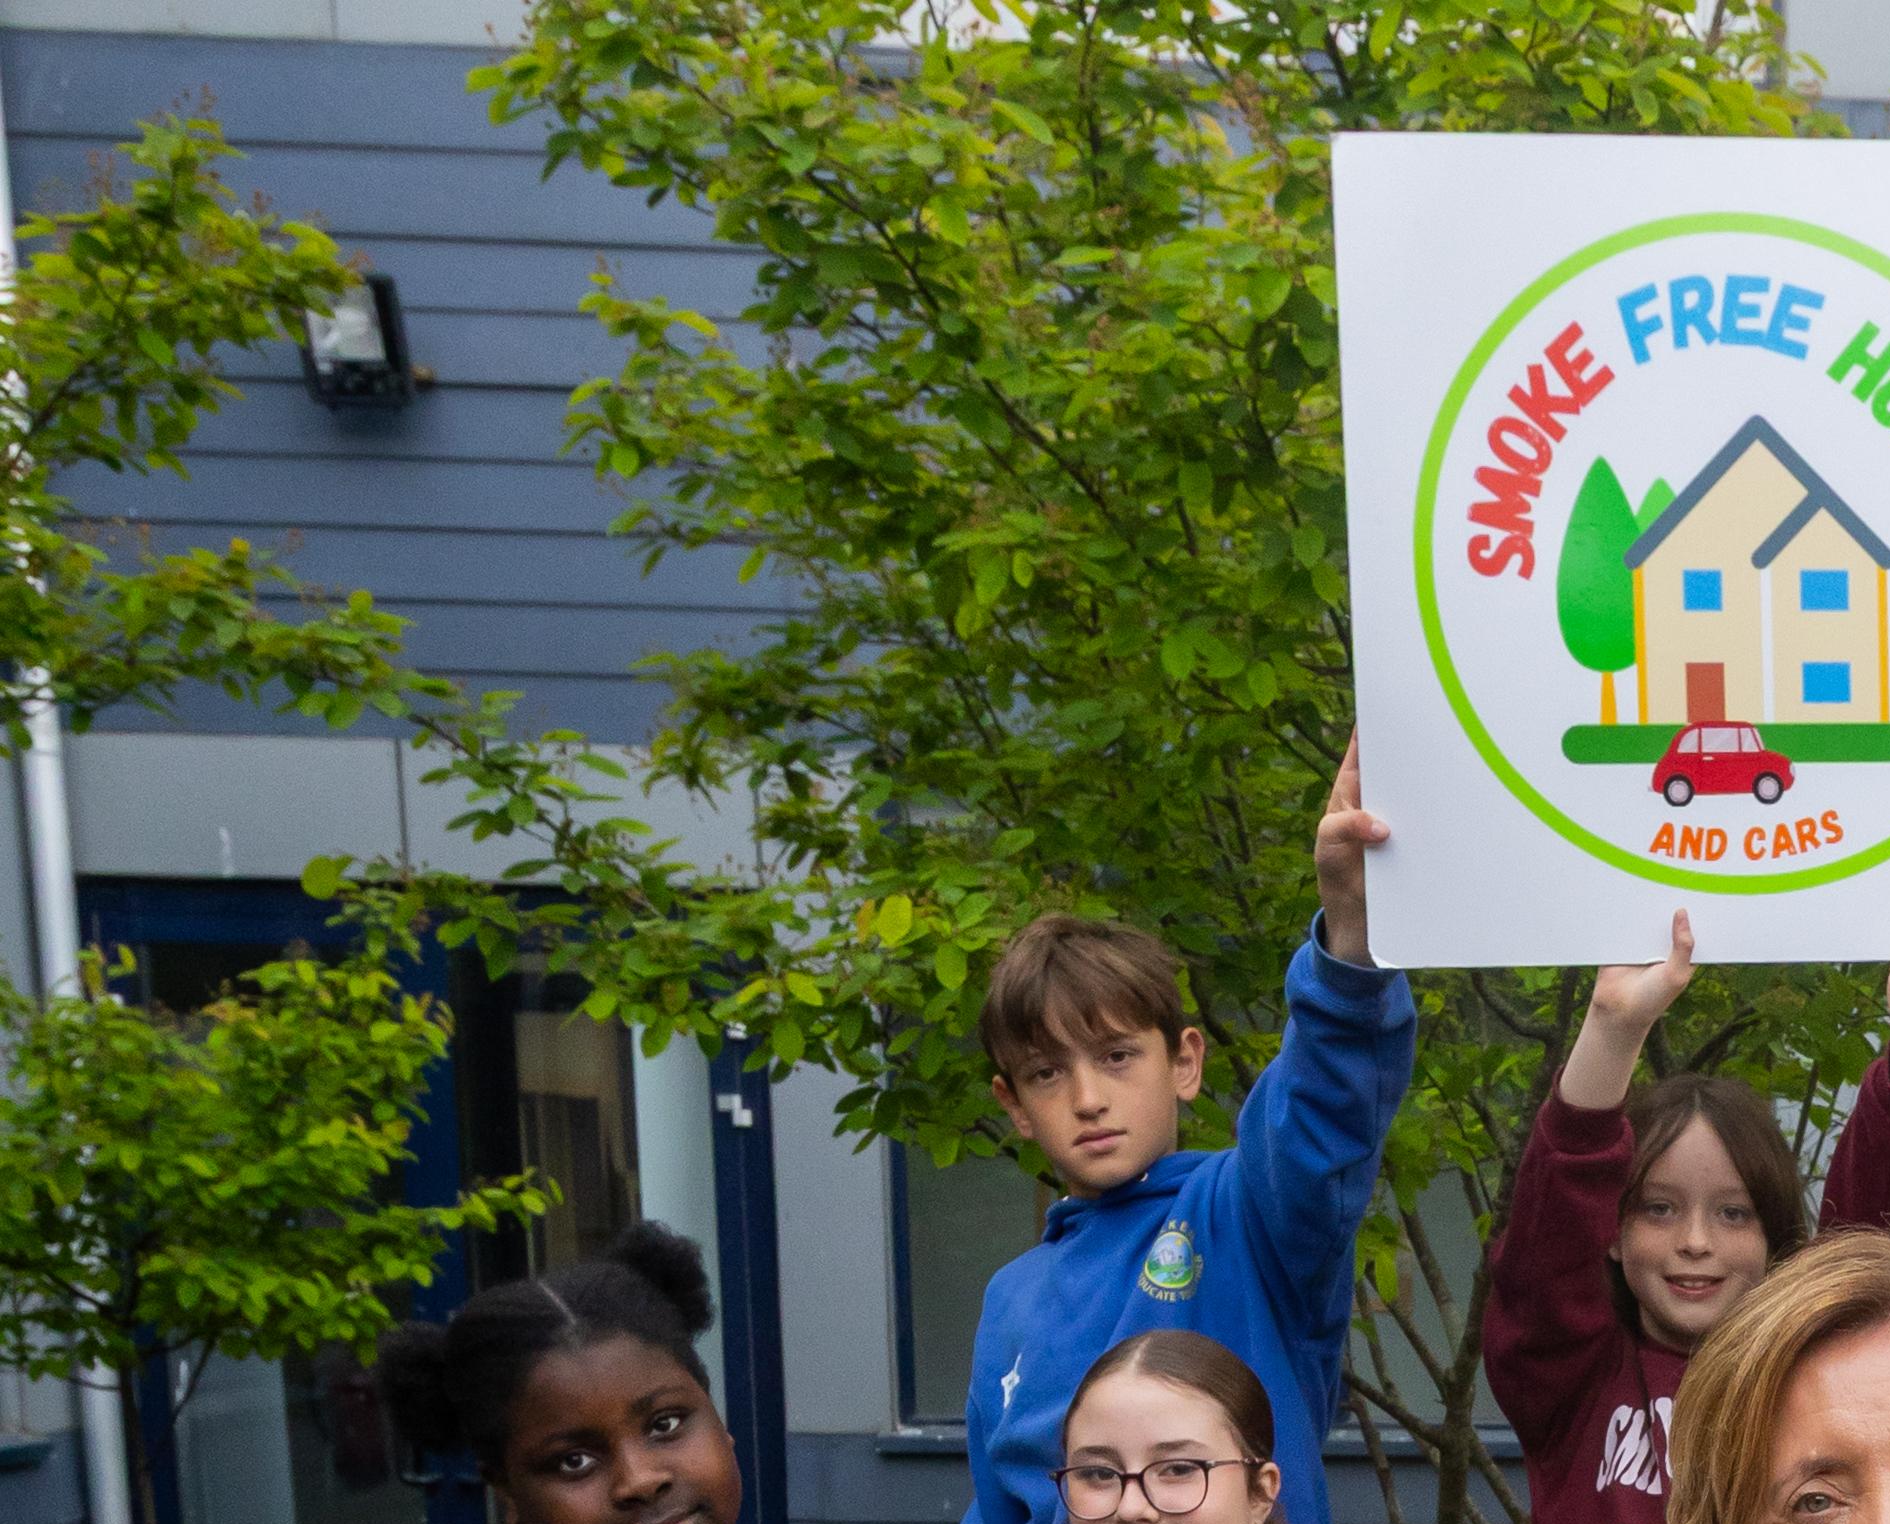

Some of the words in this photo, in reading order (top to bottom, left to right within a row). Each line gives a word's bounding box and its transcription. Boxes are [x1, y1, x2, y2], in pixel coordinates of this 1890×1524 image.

[1467, 320, 1616, 582] SMOKE
[1616, 273, 1825, 366] FREE
[1649, 822, 1728, 861] AND
[1743, 809, 1844, 861] CARS
